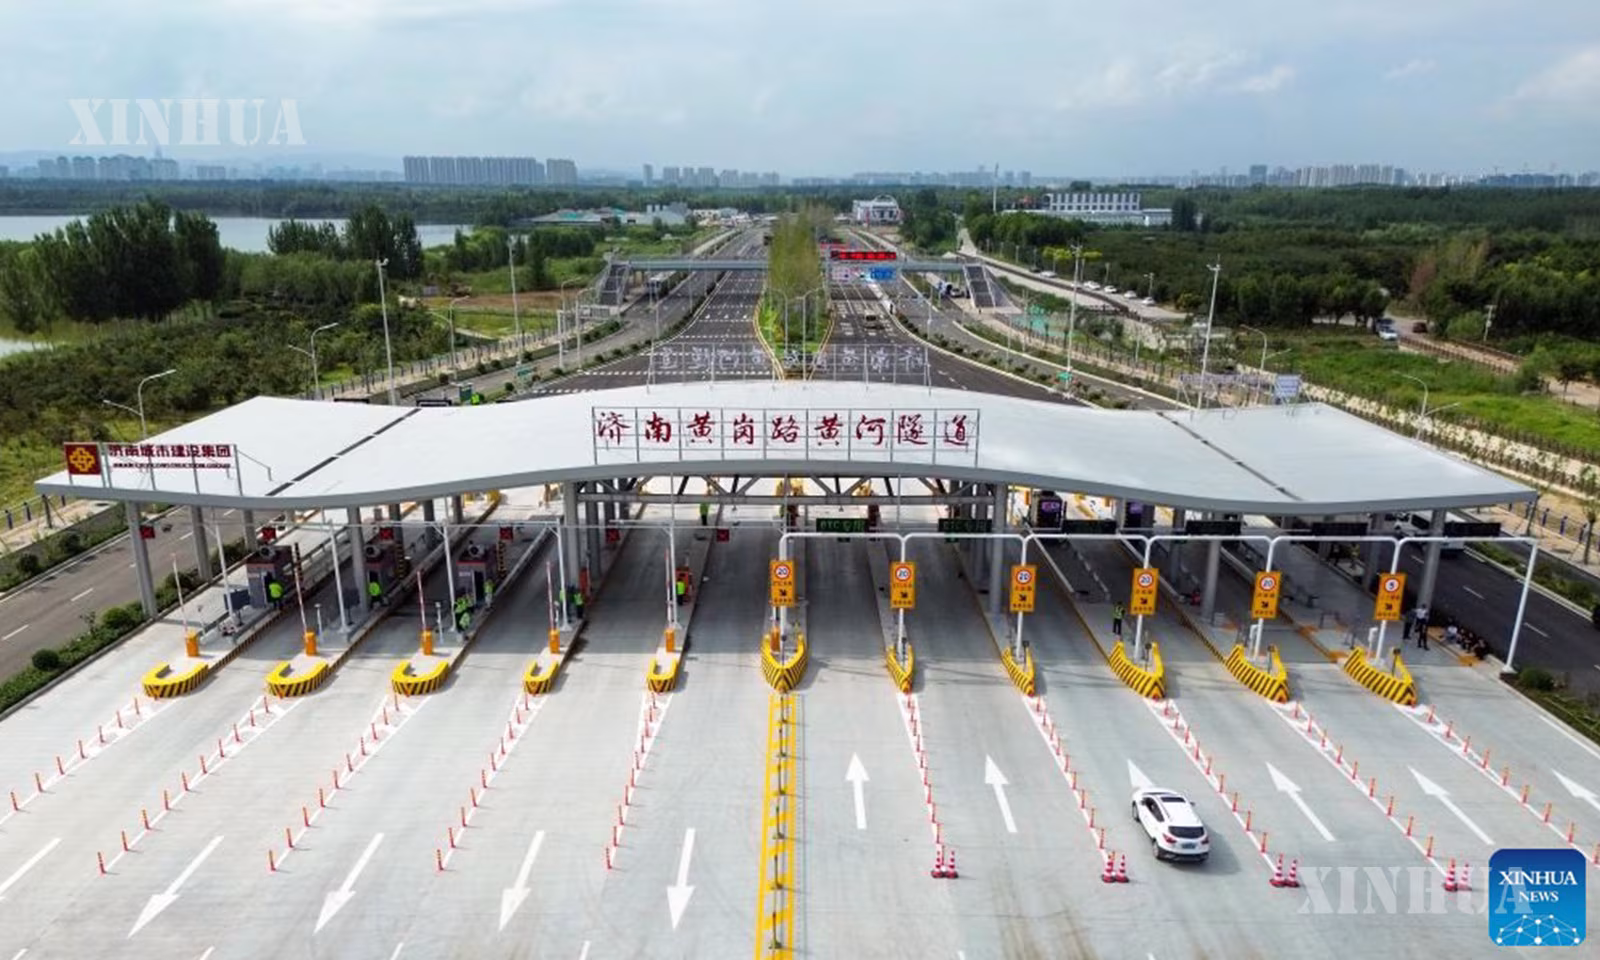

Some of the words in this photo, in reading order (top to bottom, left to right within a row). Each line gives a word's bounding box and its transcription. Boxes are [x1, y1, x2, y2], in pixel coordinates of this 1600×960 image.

[598, 411, 970, 446] 济南黄岗路黄河隧道
